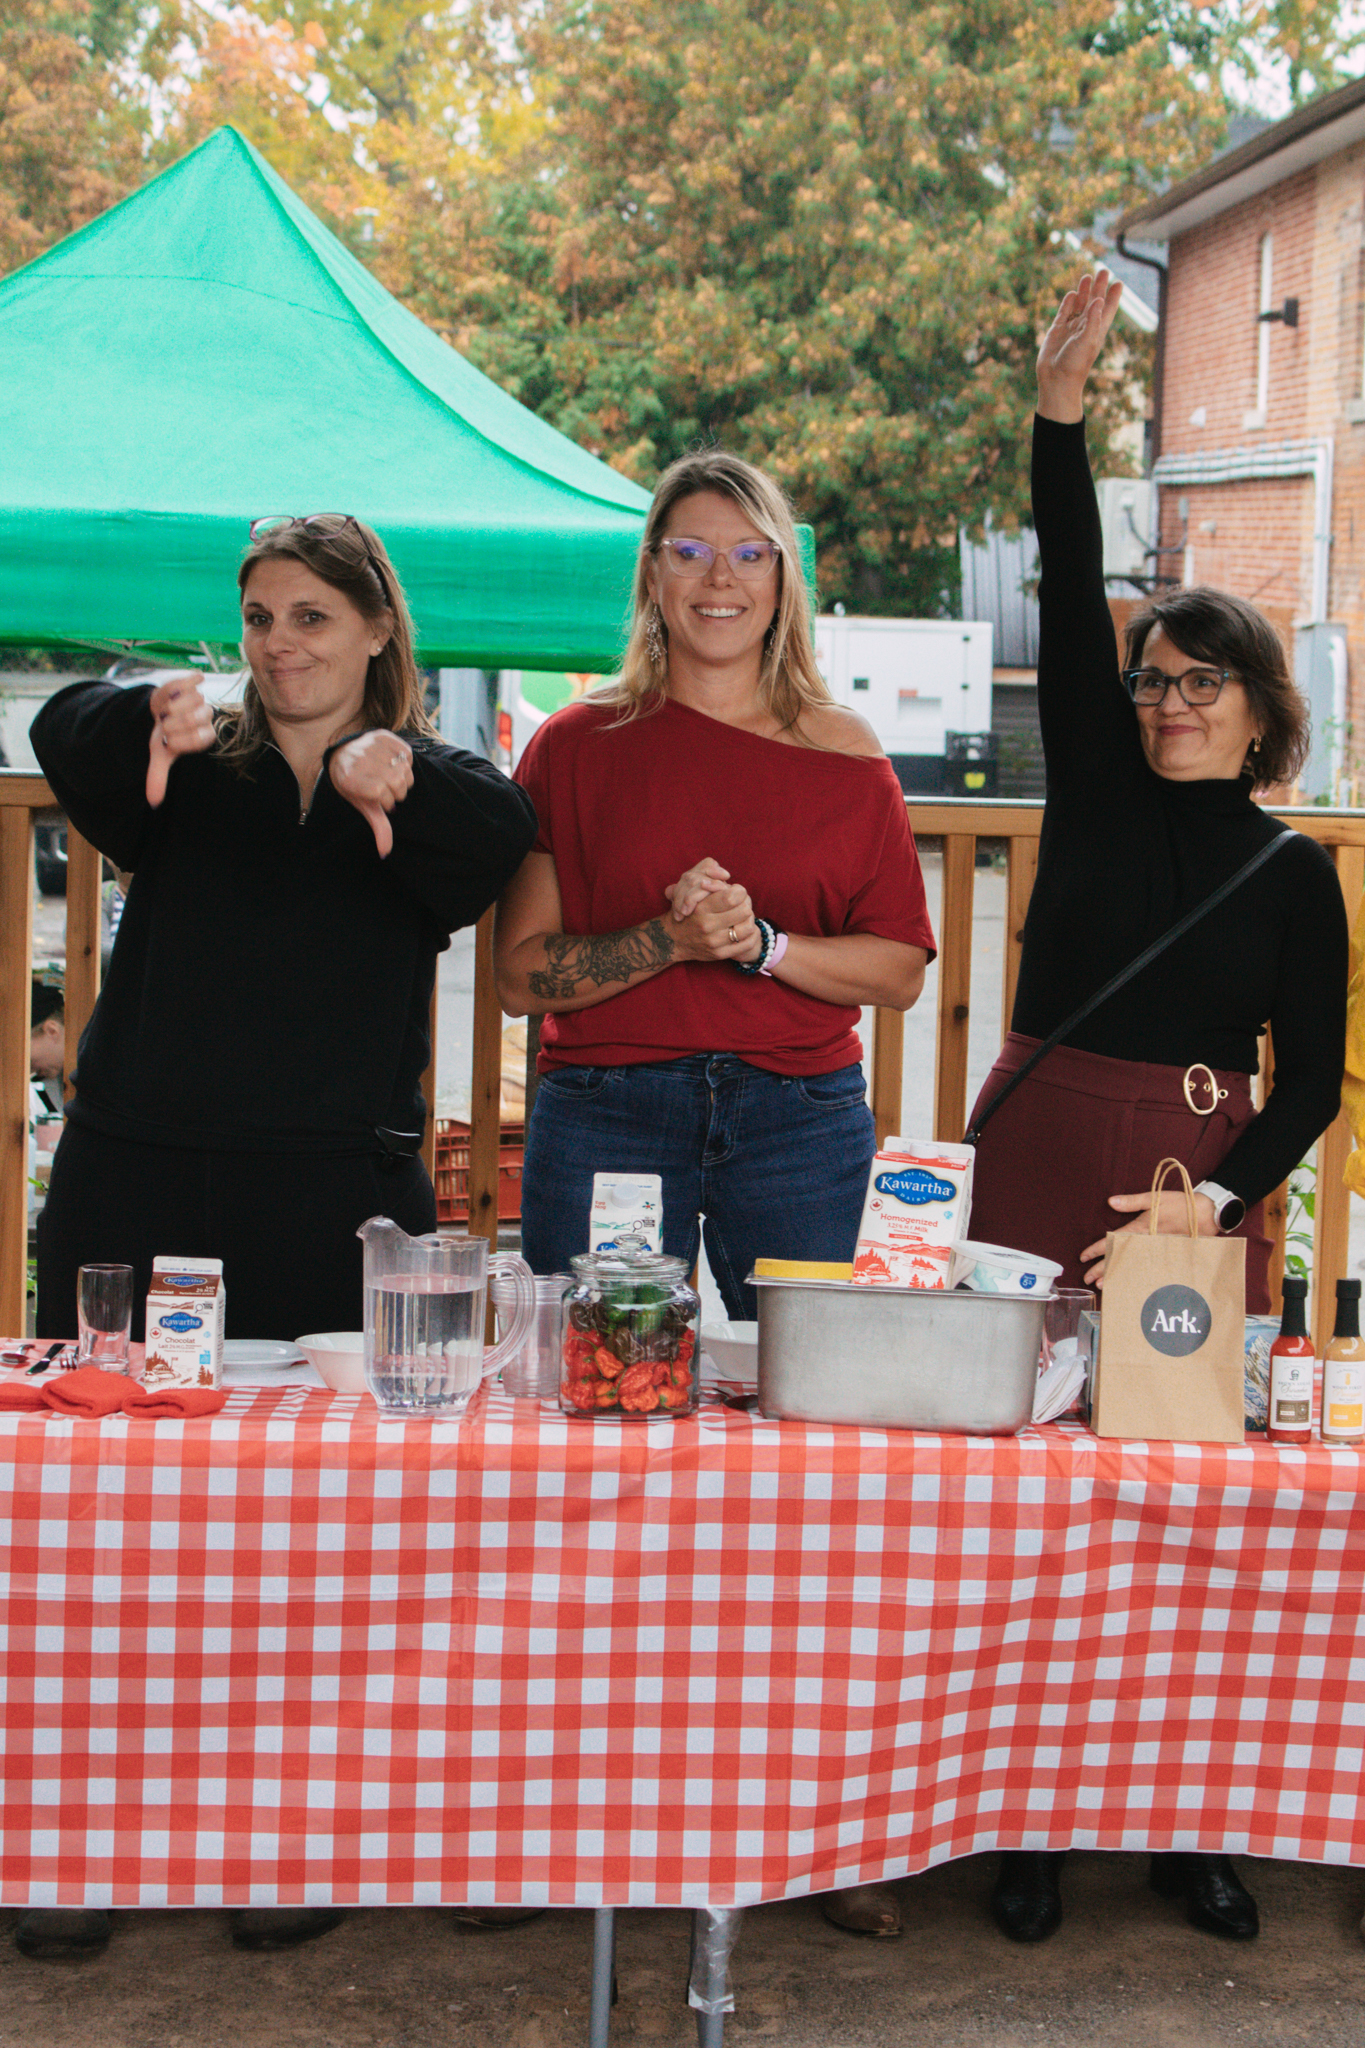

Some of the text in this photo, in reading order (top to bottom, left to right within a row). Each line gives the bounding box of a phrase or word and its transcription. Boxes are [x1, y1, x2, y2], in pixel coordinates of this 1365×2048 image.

[880, 1175, 952, 1197] Kawartha
[899, 1192, 927, 1202] DAIRY
[880, 1213, 939, 1228] Homogenized
[162, 1318, 200, 1326] Kawartha
[1150, 1308, 1202, 1334] Ark.
